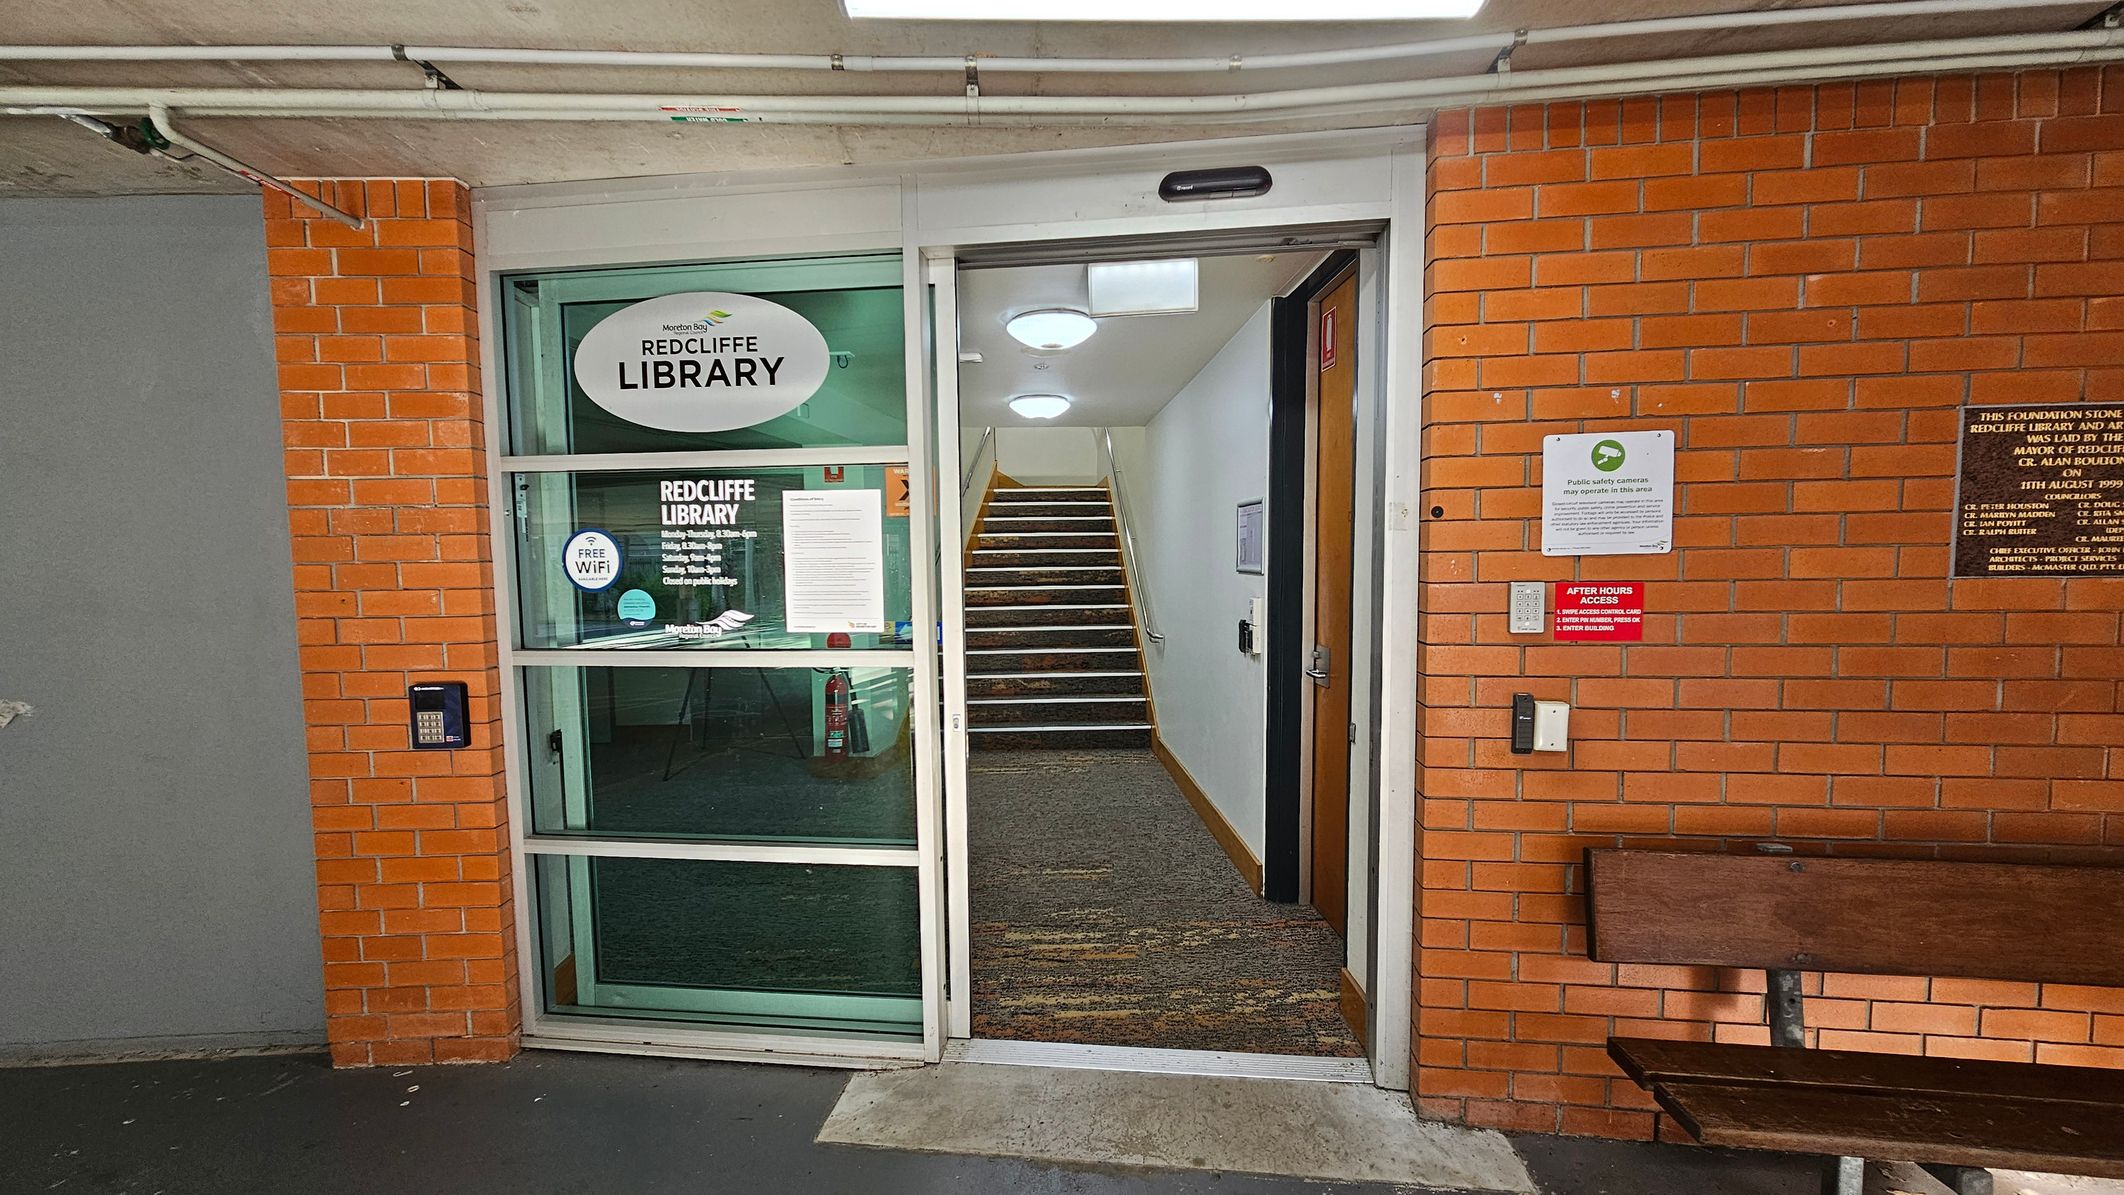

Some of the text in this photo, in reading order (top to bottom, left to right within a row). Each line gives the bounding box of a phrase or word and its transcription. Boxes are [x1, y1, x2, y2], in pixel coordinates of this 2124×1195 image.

[662, 322, 707, 333] Moreton Bay
[642, 336, 758, 356] REDCLIFFE
[618, 356, 785, 390] LIBRARY
[1980, 409, 2123, 421] THIS FOUNDATION STONE
[1970, 423, 2026, 433] REDCLIFFE
[2029, 422, 2075, 432] LIBRARY
[2078, 421, 2104, 431] AND
[2026, 433, 2124, 443] WAS LAID BY THE
[2014, 446, 2055, 455] MAYOR
[2058, 445, 2075, 454] OF
[2018, 458, 2037, 467] CR.
[2040, 457, 2071, 466] ALAN
[2062, 469, 2082, 477] ON
[2020, 480, 2124, 490] 11TH AUGUST 1999
[660, 479, 755, 502] REDCLIFFE
[661, 504, 739, 526] LIBRARY
[662, 541, 681, 552] Friday,
[578, 549, 605, 558] FREE
[662, 553, 690, 563] Saturday,
[575, 560, 610, 573] WiFi
[662, 565, 686, 575] Sunday,
[663, 577, 683, 585] Closed
[692, 577, 712, 586] public
[712, 577, 738, 587] holidays
[1567, 587, 1633, 595] AFTER HOURS
[1580, 596, 1619, 604] ACCESS
[665, 624, 722, 637] Moreton Bay
